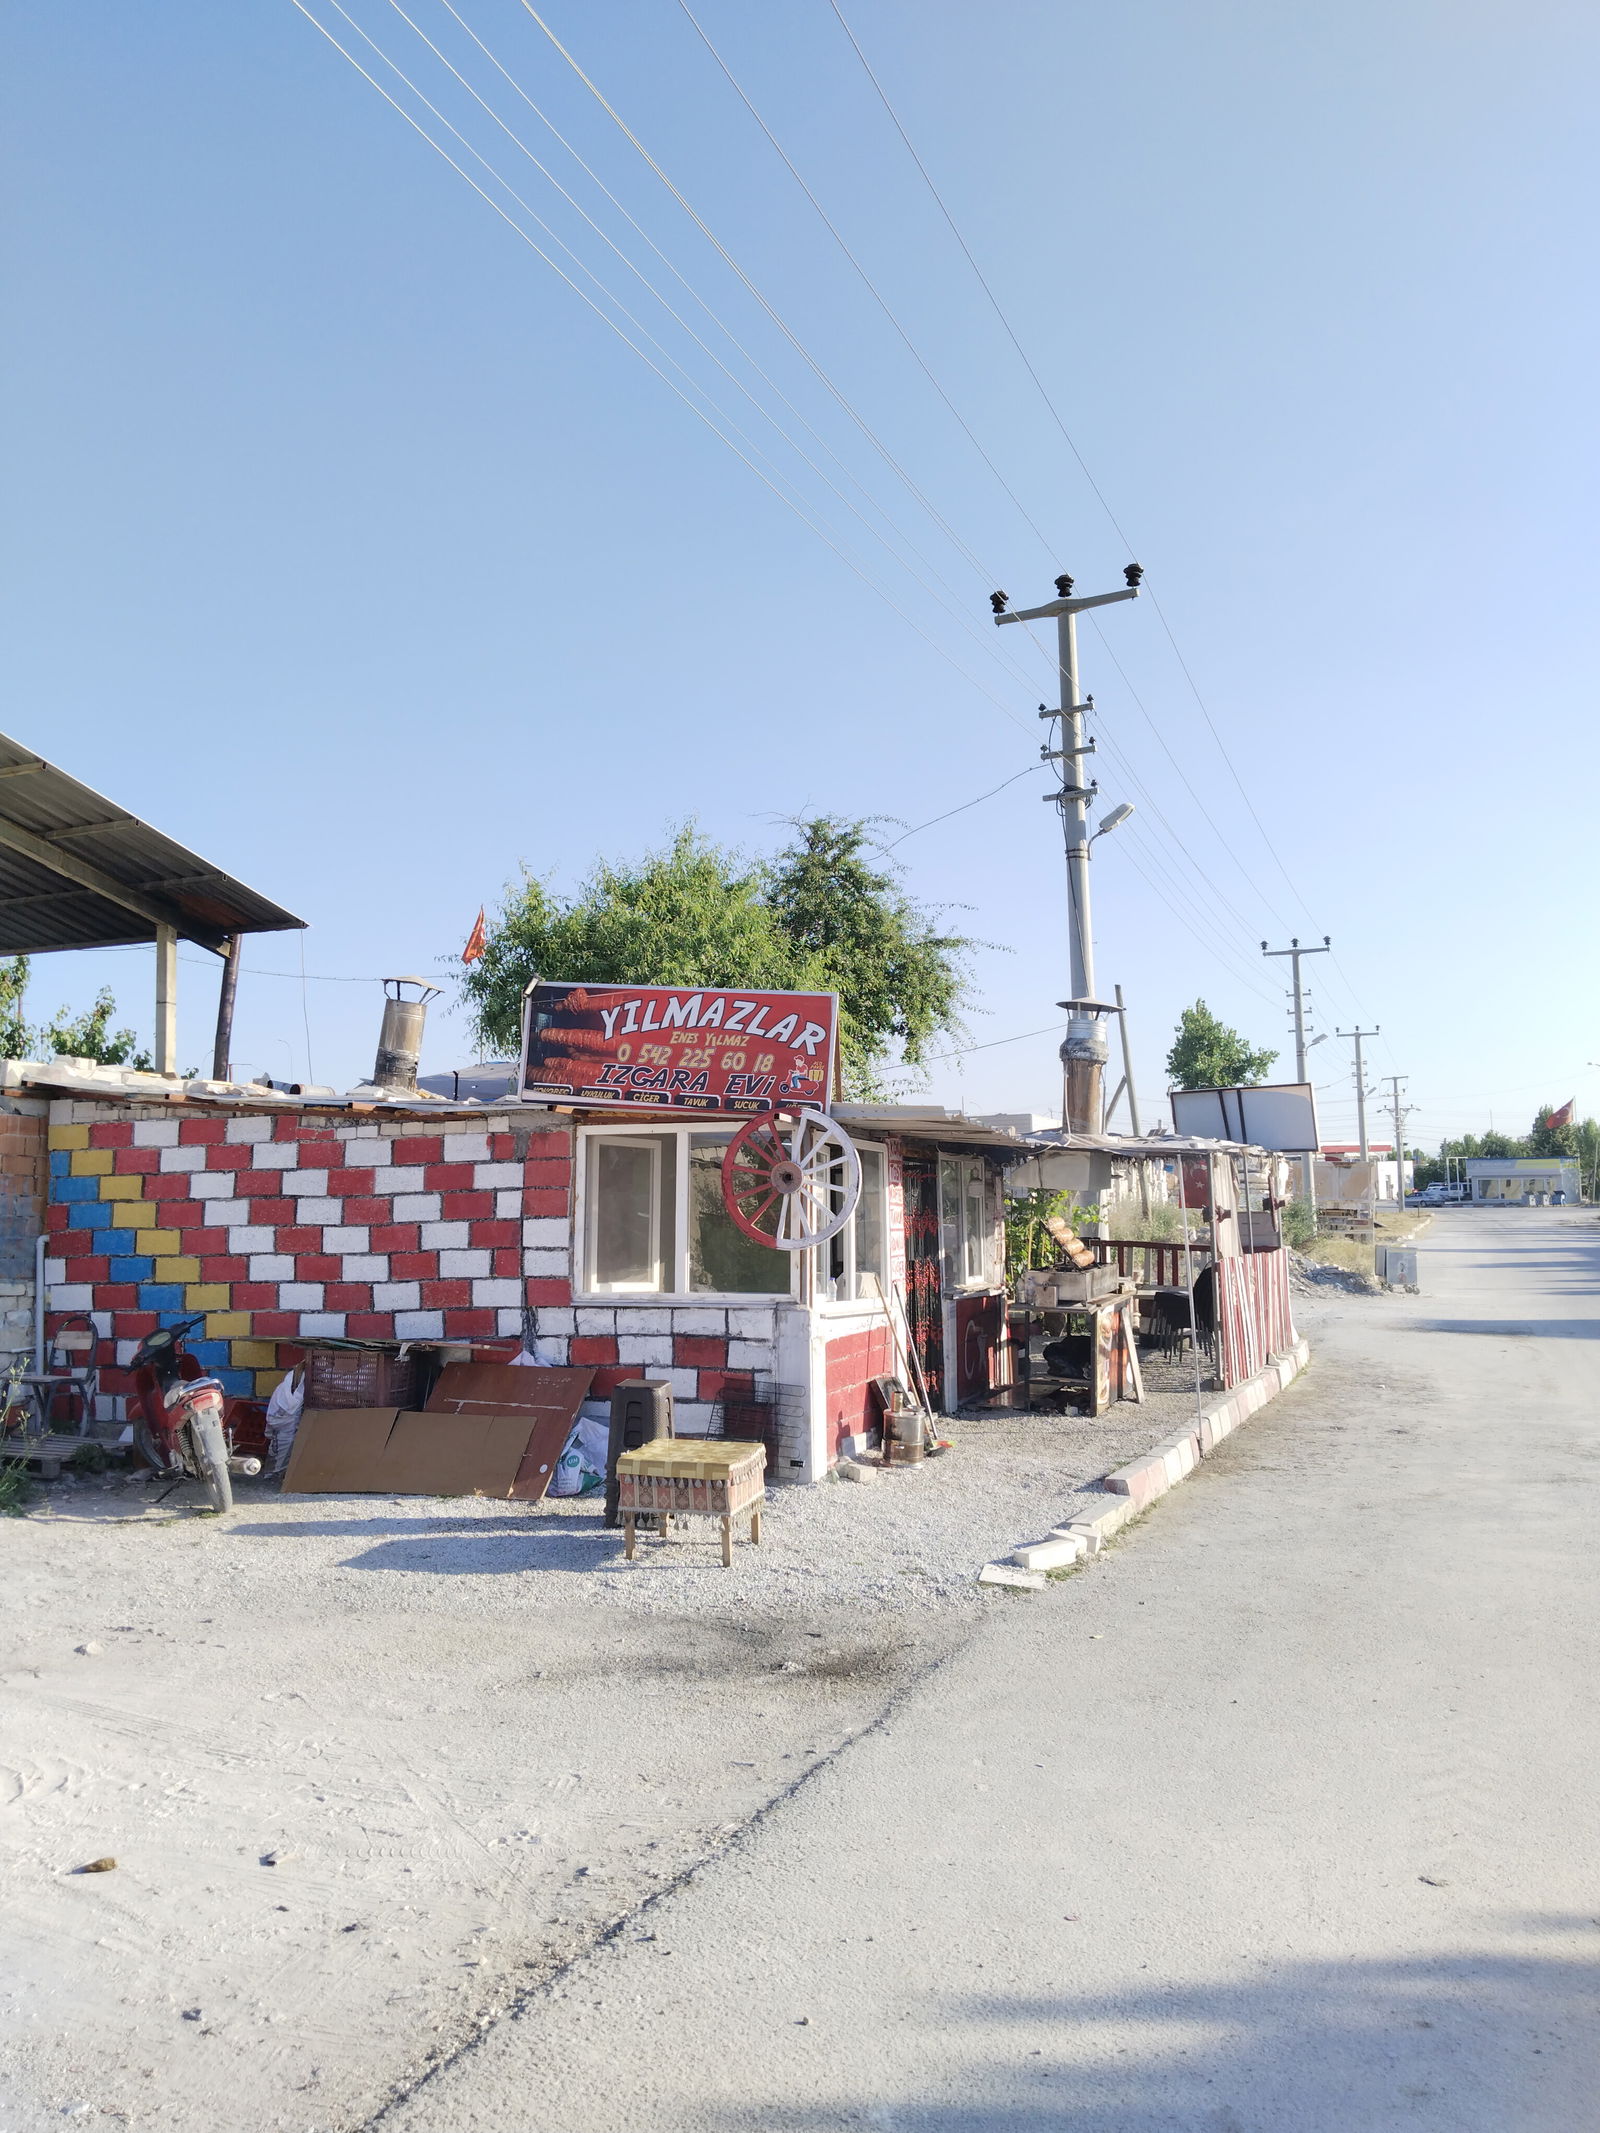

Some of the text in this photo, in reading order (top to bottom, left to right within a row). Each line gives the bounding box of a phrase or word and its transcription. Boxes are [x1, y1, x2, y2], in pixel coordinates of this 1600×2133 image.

[600, 992, 827, 1056] YILMAZLAR
[670, 1031, 700, 1044] ENES
[617, 1043, 775, 1073] 0 542 225 60 18
[595, 1062, 710, 1093] IZGARA
[684, 1097, 709, 1107] TAVUK
[734, 1100, 760, 1109] SUCUK
